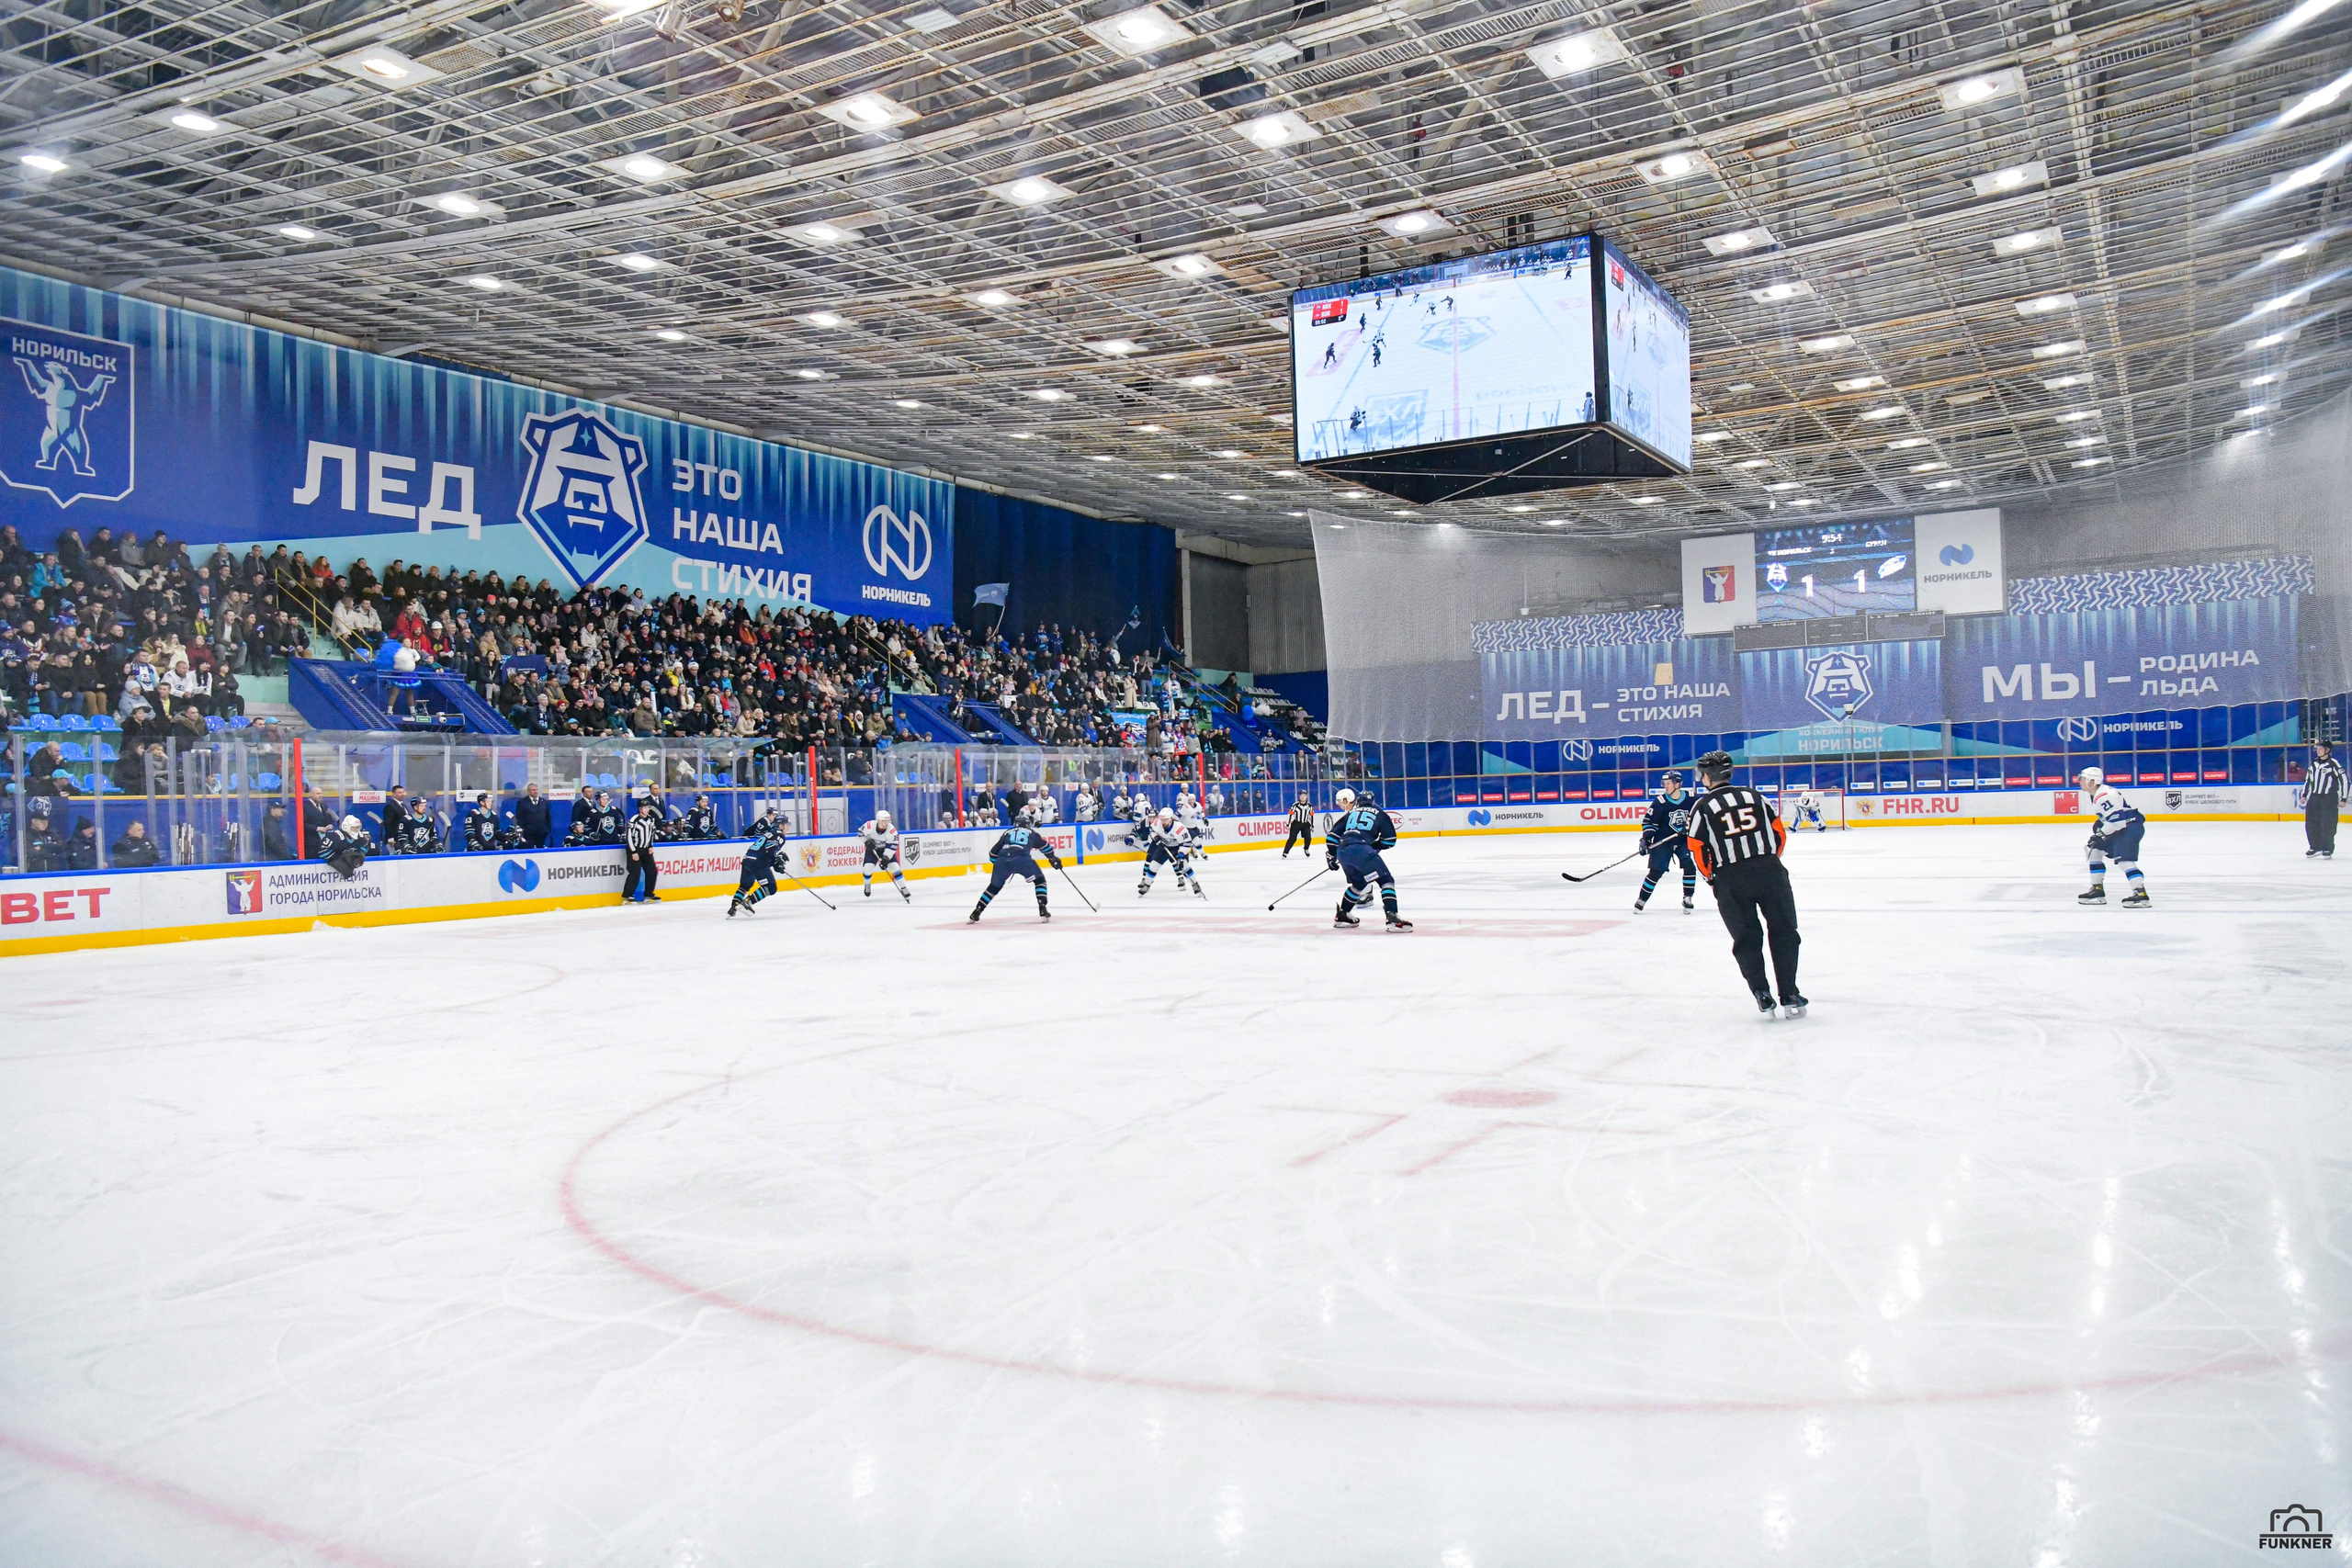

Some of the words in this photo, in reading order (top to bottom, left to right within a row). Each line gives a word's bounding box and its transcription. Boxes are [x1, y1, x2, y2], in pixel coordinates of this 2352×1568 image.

[12, 336, 118, 372] НОРИЛЬСК
[673, 458, 741, 501] ЭТО
[293, 440, 481, 540] ЛЕД
[673, 507, 784, 555] НАША
[672, 557, 812, 604] СТИХИЯ
[1801, 573, 1814, 597] 1
[1853, 569, 1866, 593] 1
[1924, 570, 1993, 583] НОРНИКЕЛЬ
[862, 584, 932, 607] НОРНИКЕЛЬ
[2140, 649, 2260, 673] РОДИНА
[1982, 660, 2097, 703] МЫ
[2140, 676, 2219, 697] ЛЬДА
[1617, 687, 1657, 703] ЭТО
[1665, 682, 1731, 700] НАША
[1497, 690, 1587, 724] ЛЕД
[1618, 704, 1702, 723] СТИХИЯ
[2103, 720, 2184, 733] НОРНИКЕЛЬ
[1599, 743, 1660, 754] НОРНИКЕЛЬ
[1798, 737, 1883, 751] НОРИЛЬСК
[1580, 807, 1647, 821] OLIMP
[1883, 797, 1959, 815] FHR.RU
[2101, 800, 2114, 811] 21
[1345, 811, 1376, 831] 45
[1495, 812, 1544, 820] НОРНИКЕЛЬ
[1720, 807, 1758, 836] 15
[1238, 821, 1290, 836] OLIMPBE
[827, 845, 865, 856] ФЕДЕРАЦИ
[1042, 835, 1073, 850] BET
[548, 864, 625, 879] НОРНИКЕЛЬ
[654, 859, 705, 875] РАСНАЯ
[827, 857, 857, 867] ХОККЕЯ
[270, 891, 314, 905] ГОРОДА
[317, 886, 382, 901] НОРИЛЬСКА
